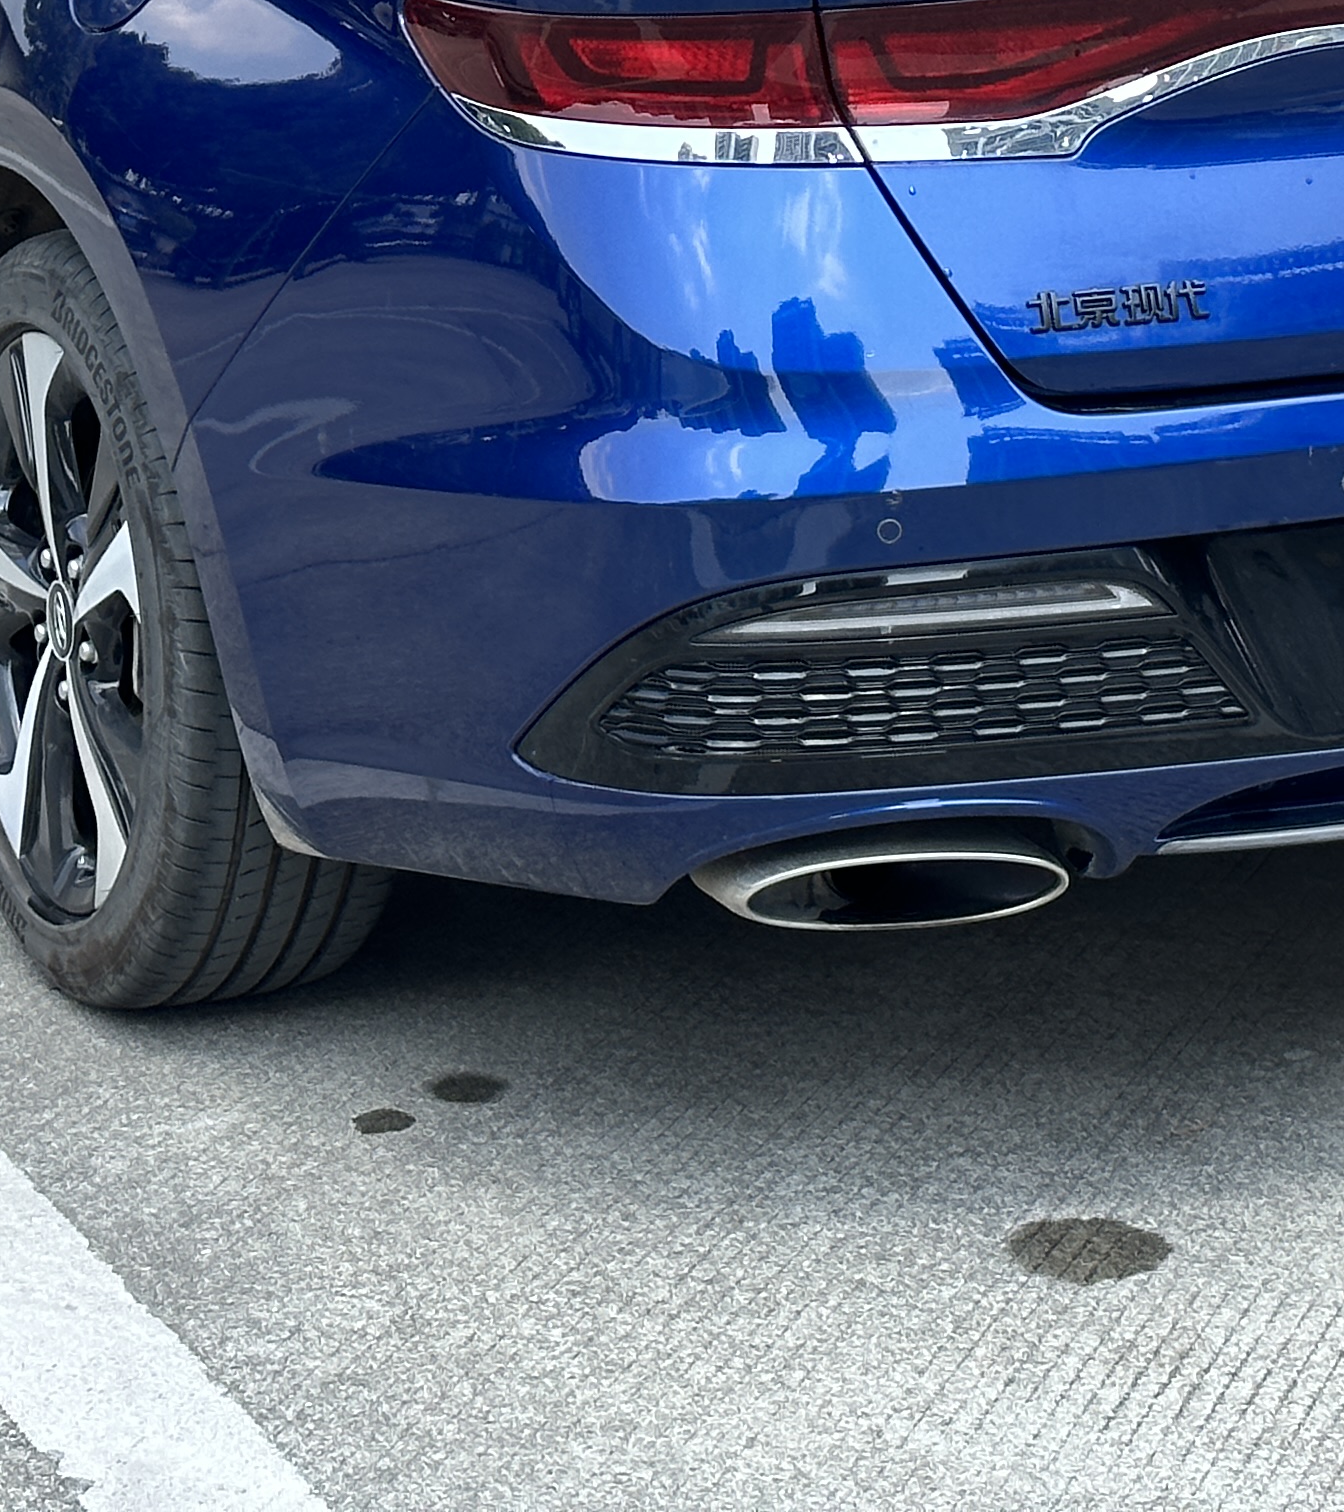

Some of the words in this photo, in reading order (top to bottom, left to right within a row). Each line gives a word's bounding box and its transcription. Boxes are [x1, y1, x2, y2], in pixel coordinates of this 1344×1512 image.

[1025, 278, 1210, 335] 北京现代
[51, 290, 141, 490] BRIDGESTONE
